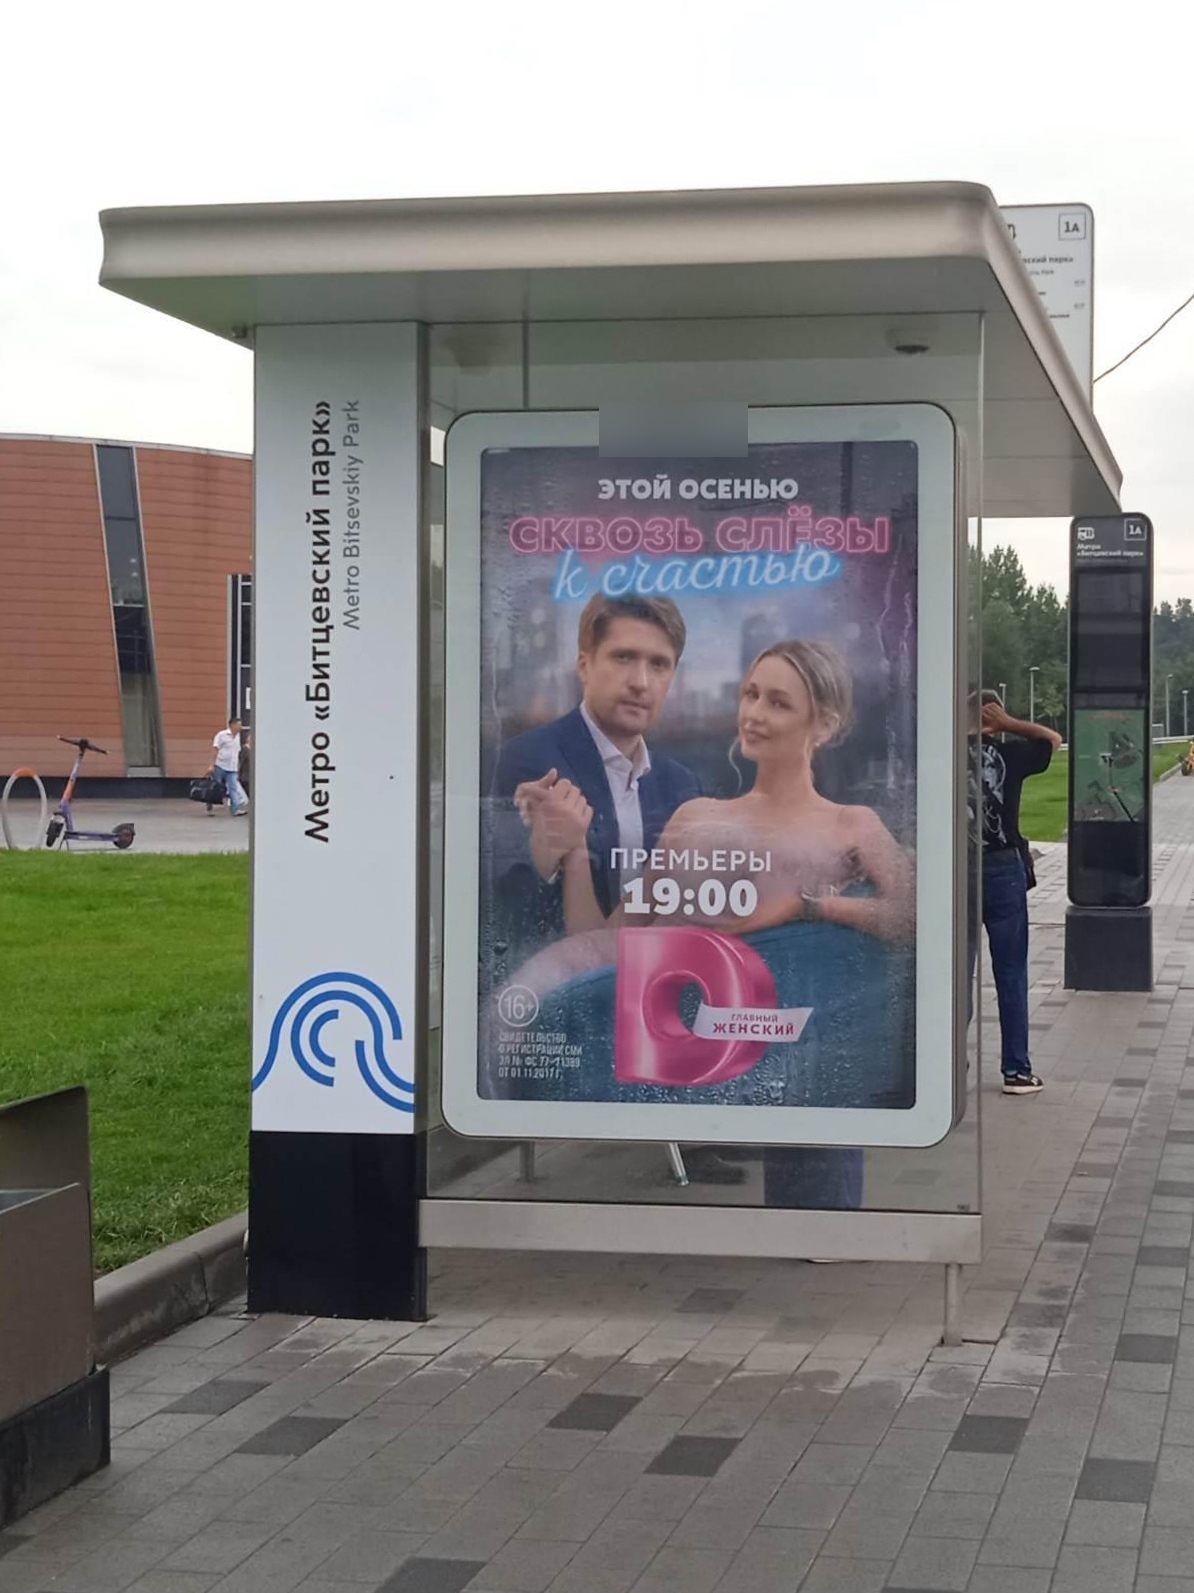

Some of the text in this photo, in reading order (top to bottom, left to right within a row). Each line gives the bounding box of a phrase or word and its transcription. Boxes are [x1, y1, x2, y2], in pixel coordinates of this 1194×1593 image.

[597, 474, 799, 501] ЭТОЙ ОСЕНЬЮ
[342, 400, 364, 630] Metro Bitsevskiy Park
[509, 504, 891, 554] СКВОЗЬ СЛЁЗЫ
[601, 543, 841, 597] счастью
[304, 401, 336, 843] Метро «Битцевский парк»
[610, 848, 772, 873] ПРЕМЬЕРЫ
[623, 877, 758, 917] 19:00
[503, 994, 535, 1020] 16+
[731, 1012, 779, 1023] ГЛАВНЫЙ
[712, 1021, 795, 1036] ЖЕНСКИЙ
